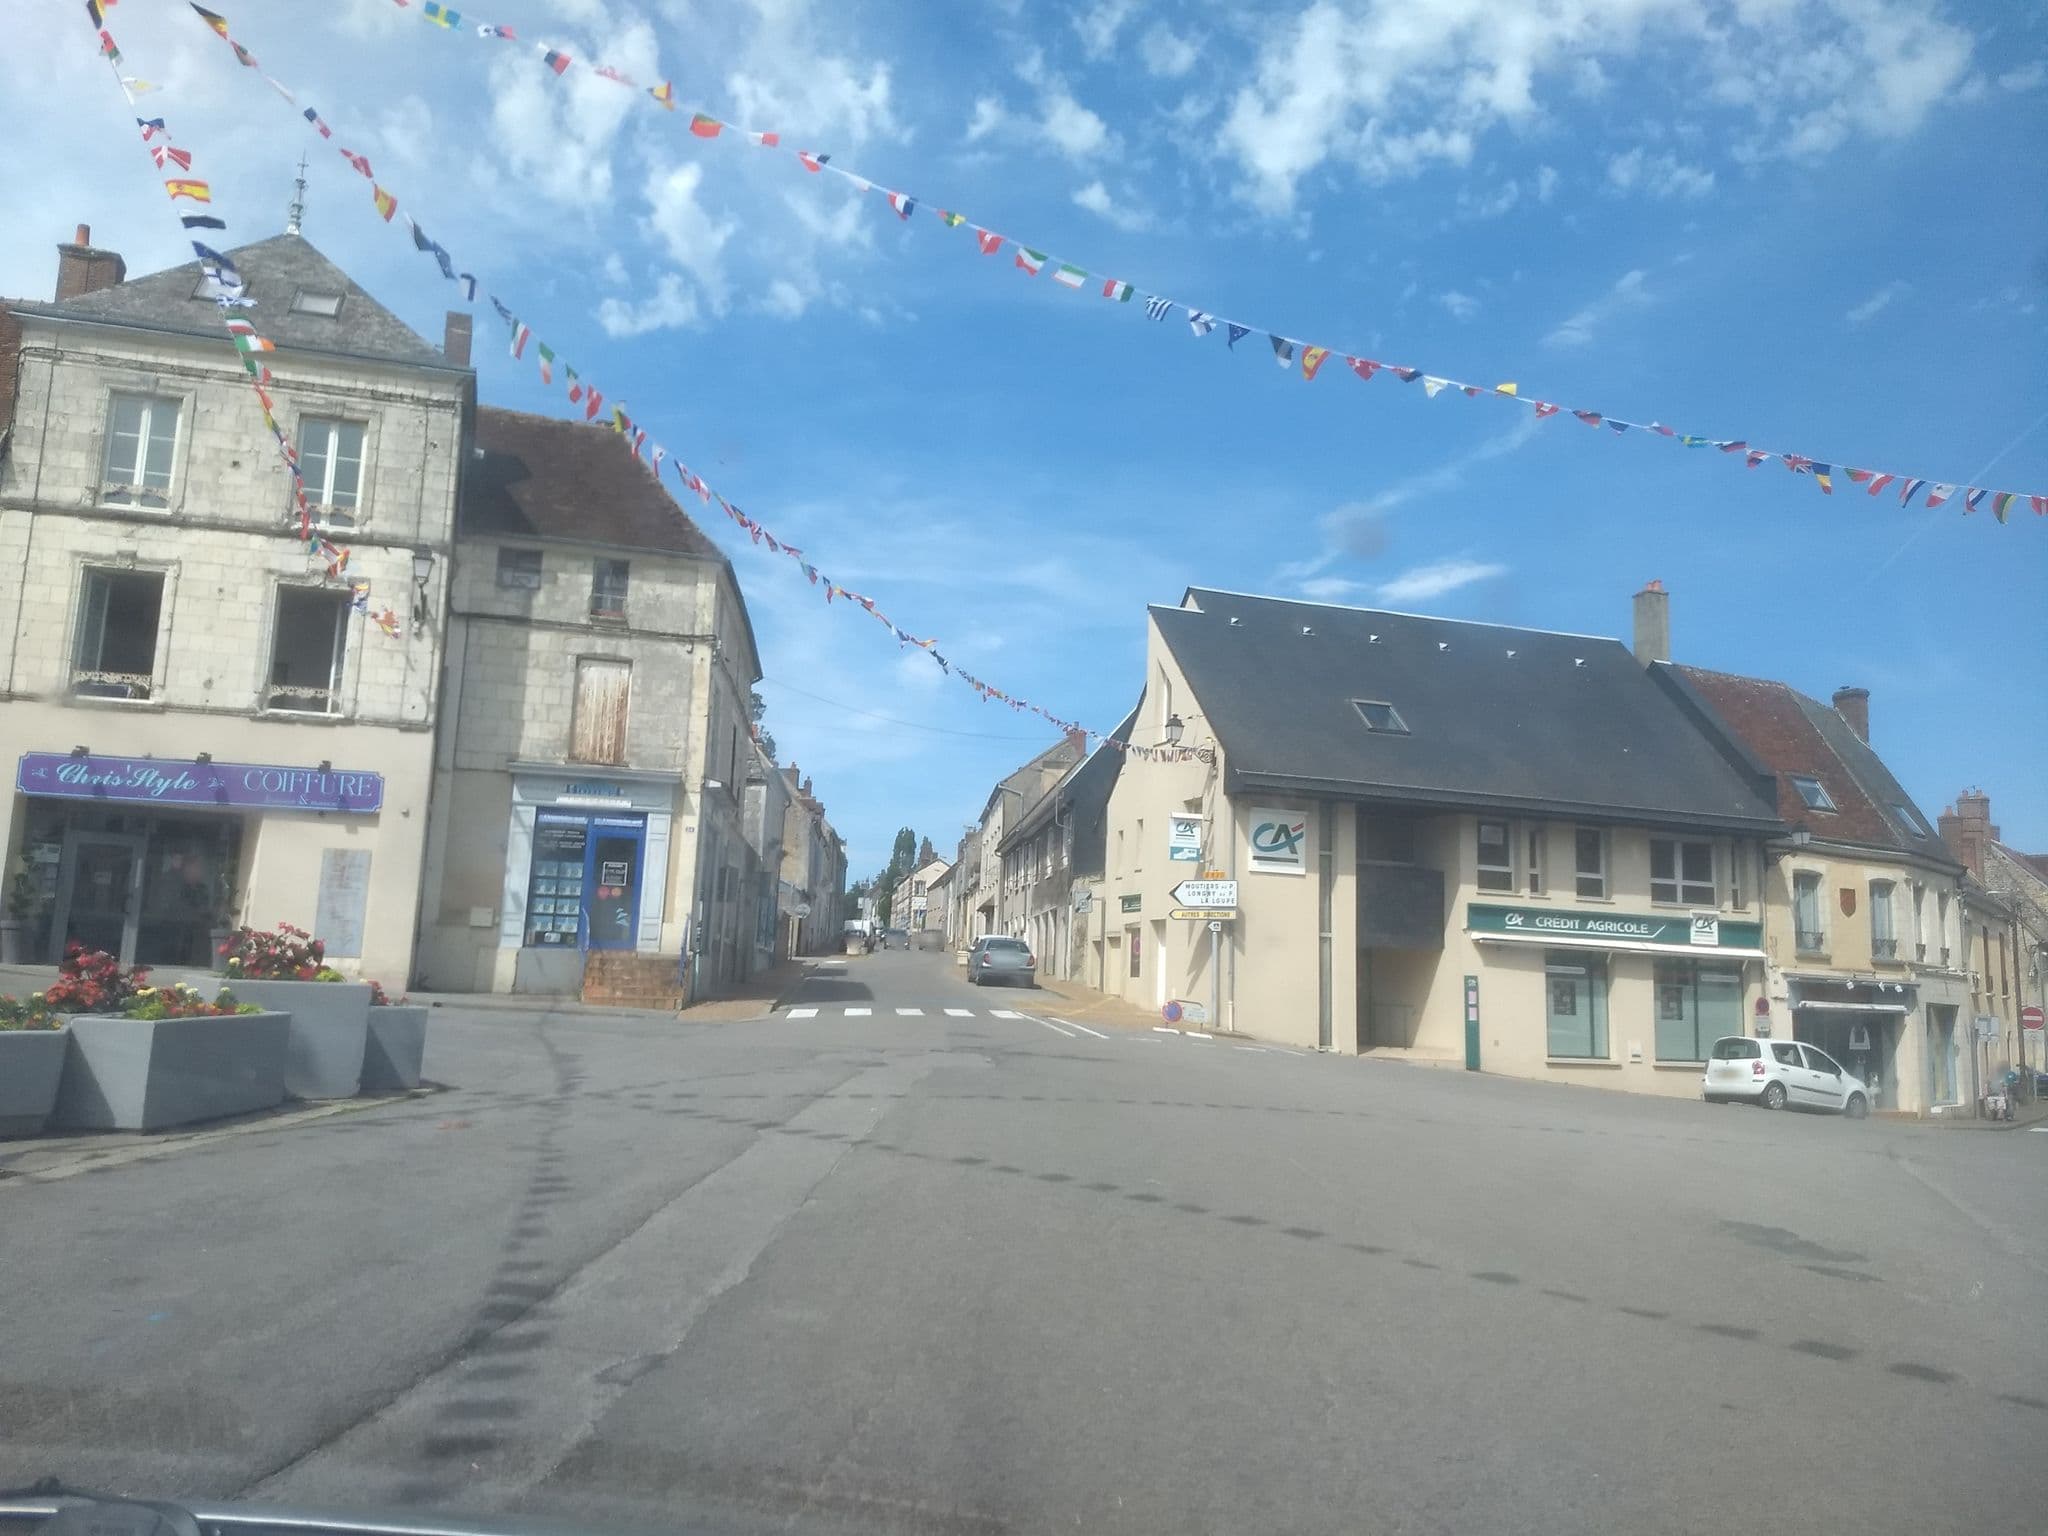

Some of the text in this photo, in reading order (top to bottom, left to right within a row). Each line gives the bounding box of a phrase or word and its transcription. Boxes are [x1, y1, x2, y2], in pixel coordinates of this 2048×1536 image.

[244, 769, 374, 798] COIFFURE
[1535, 913, 1580, 929] CRÉDIT
[1587, 919, 1649, 934] AGRICOLE
